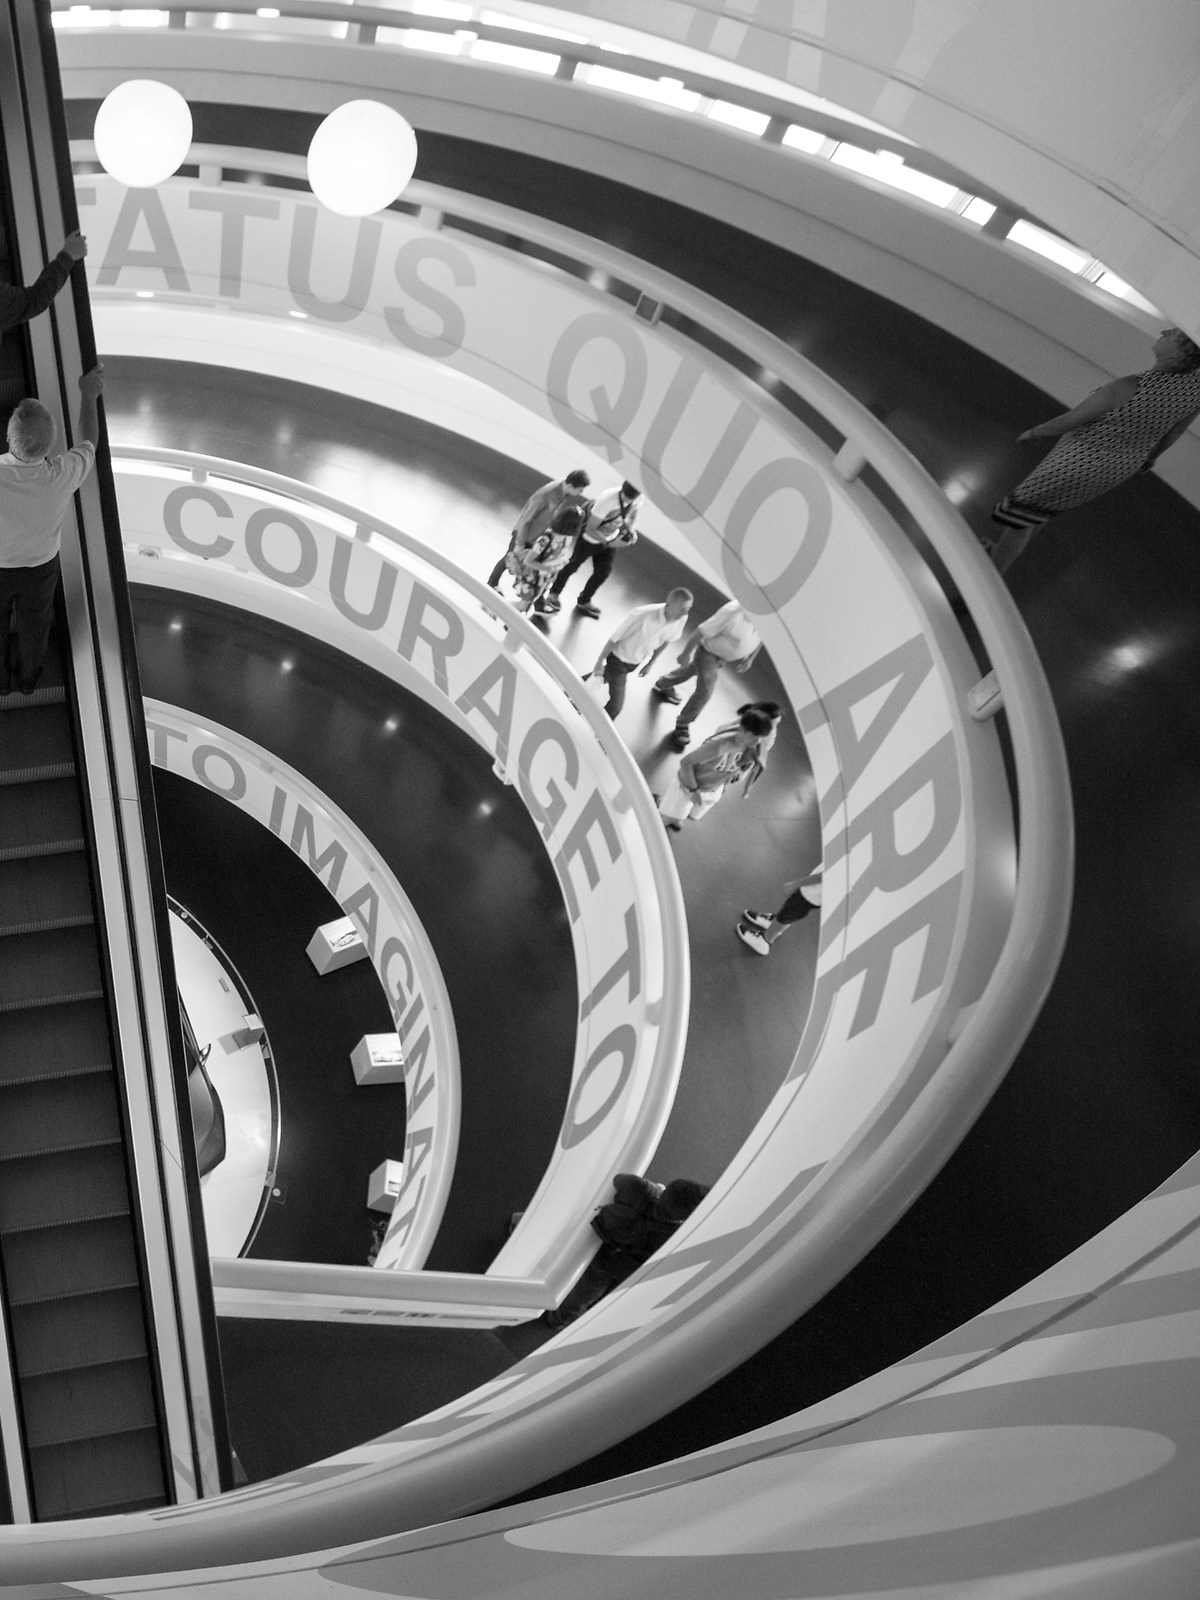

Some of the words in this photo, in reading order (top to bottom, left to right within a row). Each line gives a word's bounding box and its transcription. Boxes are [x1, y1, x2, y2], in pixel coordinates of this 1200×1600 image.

[75, 186, 477, 358] ATUS
[546, 311, 833, 616] QUO
[785, 632, 966, 1087] ARE
[163, 486, 623, 926] COURAGE
[561, 902, 641, 1150] TO
[146, 723, 247, 801] TO
[268, 784, 438, 1269] IMAGINAT
